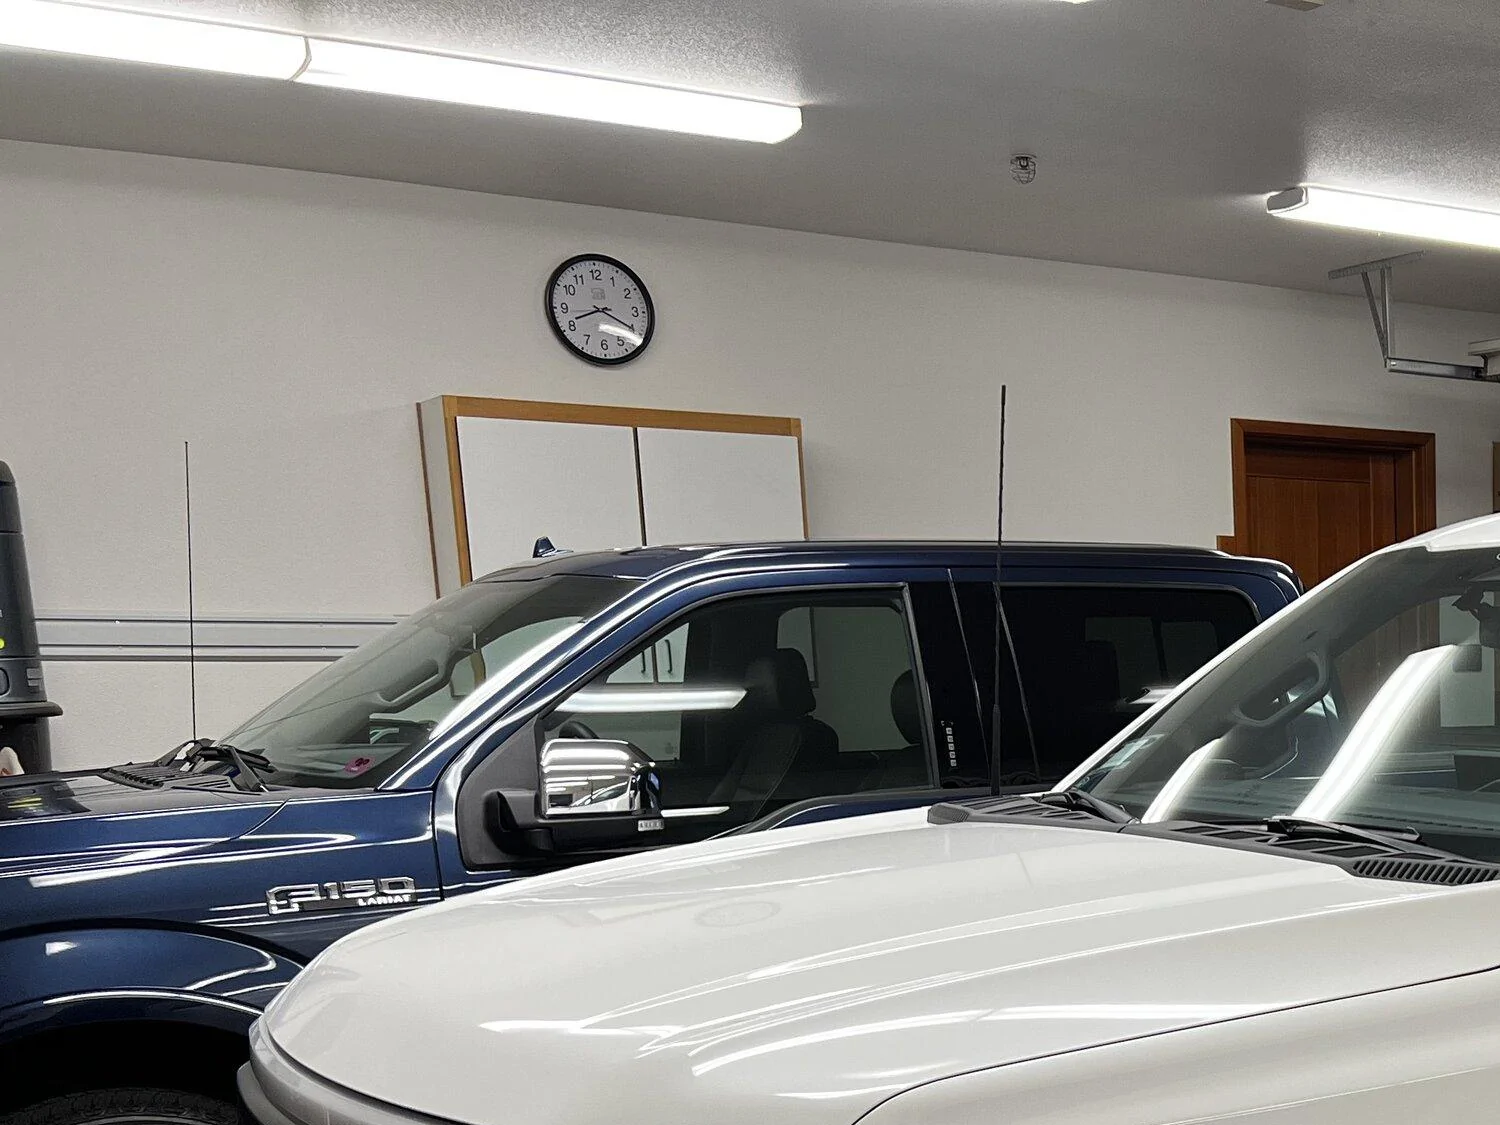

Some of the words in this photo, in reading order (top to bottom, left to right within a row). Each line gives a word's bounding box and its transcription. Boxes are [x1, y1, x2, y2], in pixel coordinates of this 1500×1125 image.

[573, 274, 584, 285] 11
[589, 269, 602, 280] 12
[610, 276, 616, 287] 1
[563, 284, 576, 296] 10
[623, 288, 632, 299] 2
[560, 302, 569, 314] 9
[631, 306, 639, 318] 3
[568, 320, 576, 331] 8
[583, 334, 591, 345] 7
[600, 339, 609, 350] 6
[617, 336, 625, 347] 5
[358, 894, 411, 906] LARIAT
